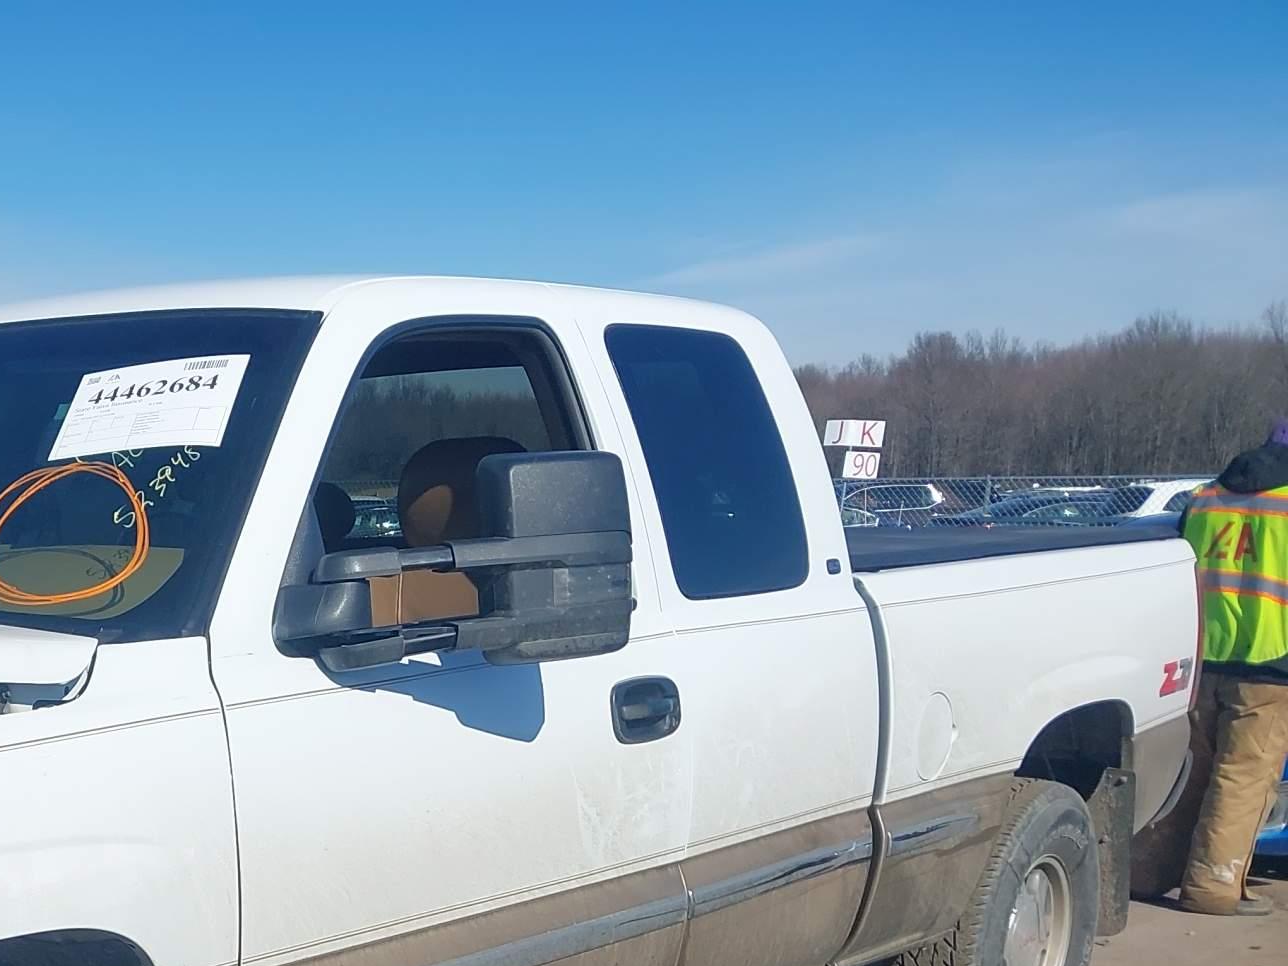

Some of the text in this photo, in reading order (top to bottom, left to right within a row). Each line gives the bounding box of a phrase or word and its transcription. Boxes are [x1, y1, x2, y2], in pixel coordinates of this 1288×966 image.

[88, 374, 218, 404] 44462684
[832, 421, 879, 445] J K
[853, 453, 877, 477] 90
